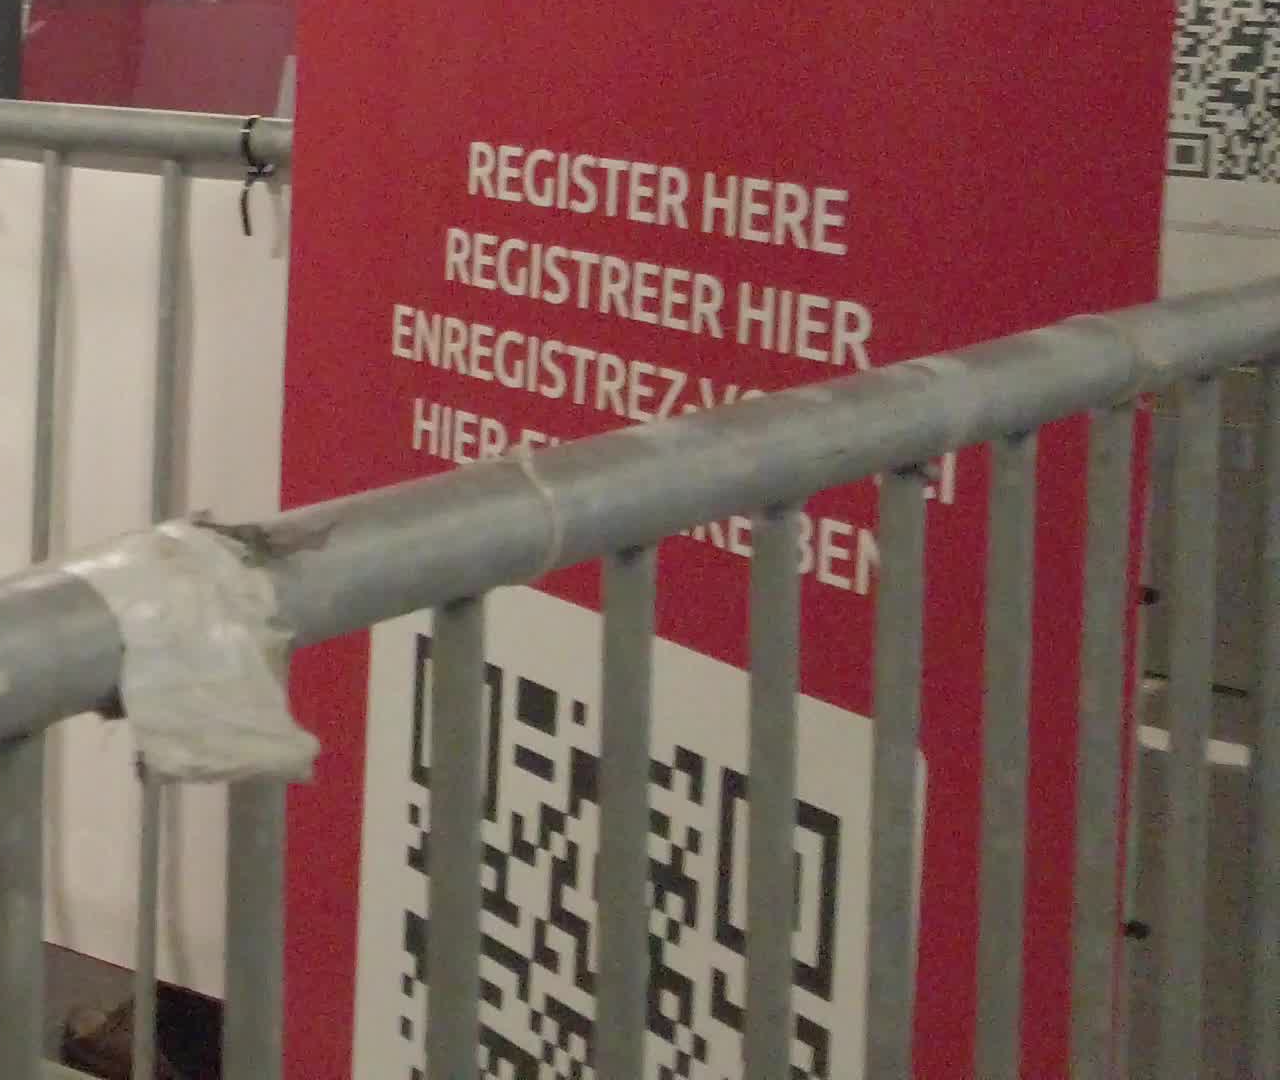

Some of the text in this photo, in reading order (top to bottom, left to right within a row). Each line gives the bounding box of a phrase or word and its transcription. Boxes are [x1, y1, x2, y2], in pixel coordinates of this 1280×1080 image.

[468, 140, 848, 256] REGISTER HERE
[445, 227, 873, 370] REGISTREER HIER
